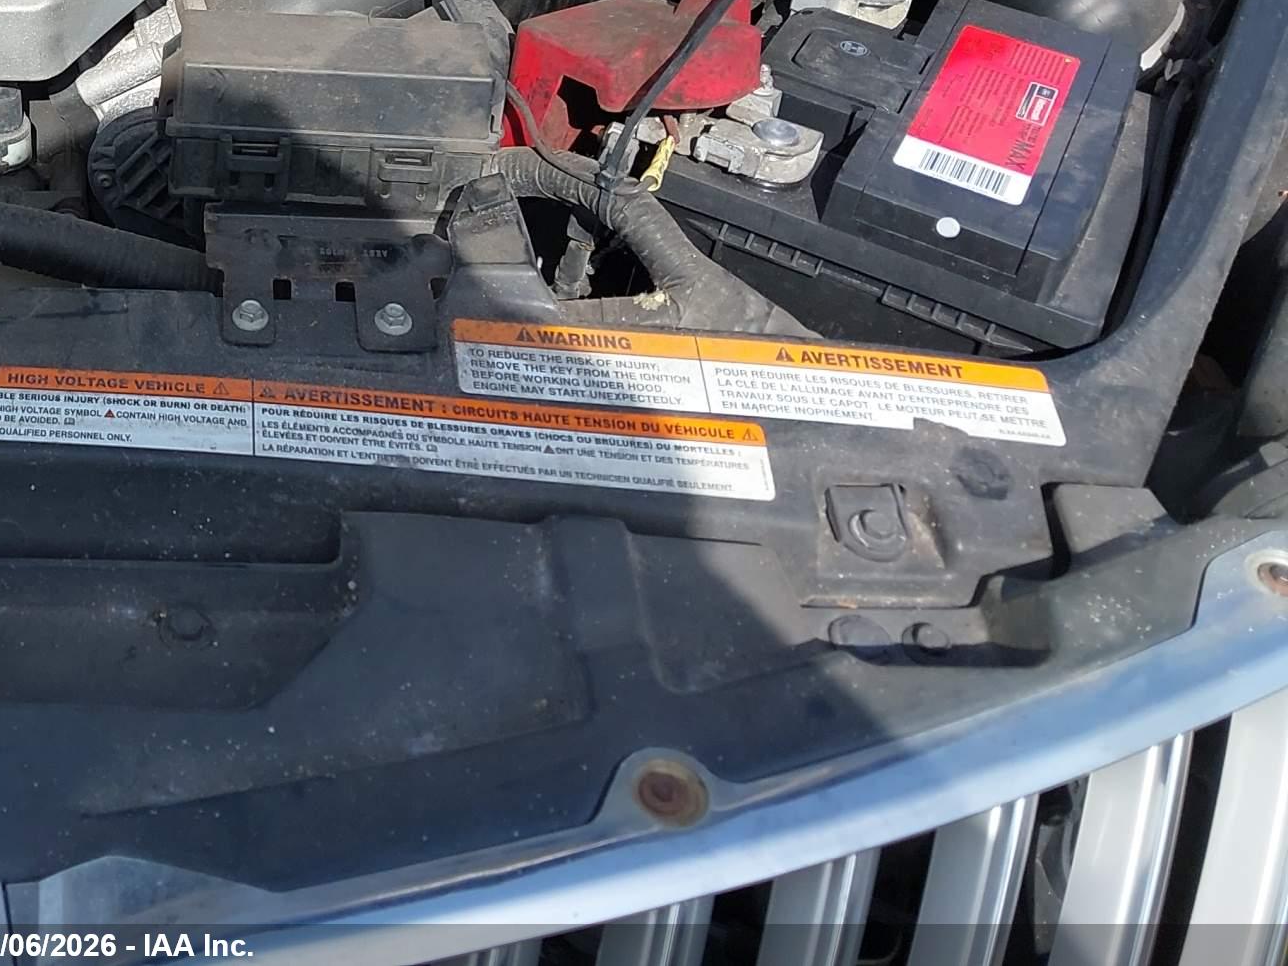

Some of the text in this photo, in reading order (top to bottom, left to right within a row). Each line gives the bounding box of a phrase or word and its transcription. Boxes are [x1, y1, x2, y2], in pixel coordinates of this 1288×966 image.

[536, 329, 631, 349] WARNING
[469, 348, 484, 357] TO
[487, 349, 536, 361] REDUCE
[538, 353, 562, 363] THE
[565, 356, 594, 366] RISK
[595, 358, 611, 367] OF
[799, 350, 963, 379] AVERTISSEMENT
[470, 359, 690, 384] REMOVE THE KEY FROM THE IGNITION
[471, 369, 520, 382] BEFORE
[522, 374, 580, 387] WORKING
[582, 379, 624, 390] UNDER
[7, 373, 48, 386] HIGH
[54, 376, 128, 390] VOLTAGE
[133, 379, 204, 393] VEHICLE
[472, 380, 516, 392] ENGINE
[520, 384, 544, 394] MAY
[548, 386, 586, 398] START
[714, 367, 747, 378] POUR
[750, 369, 800, 382] RÉDUIRE
[804, 375, 826, 384] LES
[829, 377, 881, 389] RISQUES
[883, 382, 898, 391] DE
[977, 391, 1027, 405] RETIRER
[18, 393, 60, 403] SERIOUS
[63, 395, 99, 405] INJURY
[102, 397, 140, 407] (SHOCK
[143, 399, 156, 408] OR
[160, 400, 190, 409] BURN)
[193, 402, 207, 410] OR
[716, 378, 731, 387] LA
[760, 381, 776, 390] DE
[857, 390, 893, 401] AVANT
[1005, 405, 1029, 416] DES
[721, 400, 737, 409] EN
[740, 401, 790, 414] MARCHE
[3, 414, 15, 422] BE
[18, 415, 60, 425] AVOIDED.
[20, 406, 61, 415] VOLTAGE
[64, 408, 102, 417] SYMBOL
[115, 410, 155, 421] CONTAIN
[158, 413, 180, 423] HIGH
[183, 415, 224, 426] VOLTAGE
[227, 418, 248, 427] AND
[283, 386, 434, 413] AVERTISSEMENT
[451, 404, 518, 421] CIRCUITS
[522, 410, 569, 425] HAUTE
[574, 415, 636, 431] TENSION
[640, 421, 660, 434] DU
[663, 422, 734, 440] VÉHICULE
[719, 389, 772, 401] TRAVAUX
[775, 394, 808, 404] SOUS
[811, 397, 824, 406] LE
[877, 403, 891, 412] LE
[895, 405, 945, 417] MOTEUR
[947, 410, 977, 421] PEUT
[978, 413, 995, 423] SE
[999, 415, 1046, 428] METTRE
[48, 430, 104, 440] PERSONNEL
[106, 432, 132, 442] ONLY.
[261, 406, 289, 417] POUR
[292, 408, 337, 421] RÉDUIRE
[340, 413, 359, 423] LES
[362, 415, 407, 427] RISQUES
[410, 420, 423, 428] DE
[426, 421, 487, 434] BLESSURES
[489, 427, 531, 438] GRAVES
[533, 430, 573, 442] (CHOCS
[576, 434, 591, 443] OU
[655, 441, 671, 450] OU
[673, 443, 734, 456] MORTELLES
[261, 419, 278, 428] LES
[281, 420, 330, 433] ÉLÉMENTS
[405, 432, 419, 441] DU
[420, 434, 466, 445] SYMBOLE
[467, 438, 499, 448] HAUTE
[501, 441, 542, 452] TENSION
[553, 446, 574, 455] ONT
[576, 448, 595, 457] UNE
[598, 450, 639, 461] TENSION
[640, 453, 652, 462] ET
[654, 455, 673, 464] DES
[262, 428, 423, 451] ÉLEVÉES ET DOIVENT ÊTRE ÉVITÉS.
[262, 442, 274, 451] LA
[276, 442, 334, 457] RÉPARATION
[336, 449, 347, 458] ET
[411, 456, 452, 467] DOIVENT
[455, 459, 479, 470] ÊTRE
[537, 467, 557, 477] PAR
[574, 470, 630, 483] TECHNICIEN
